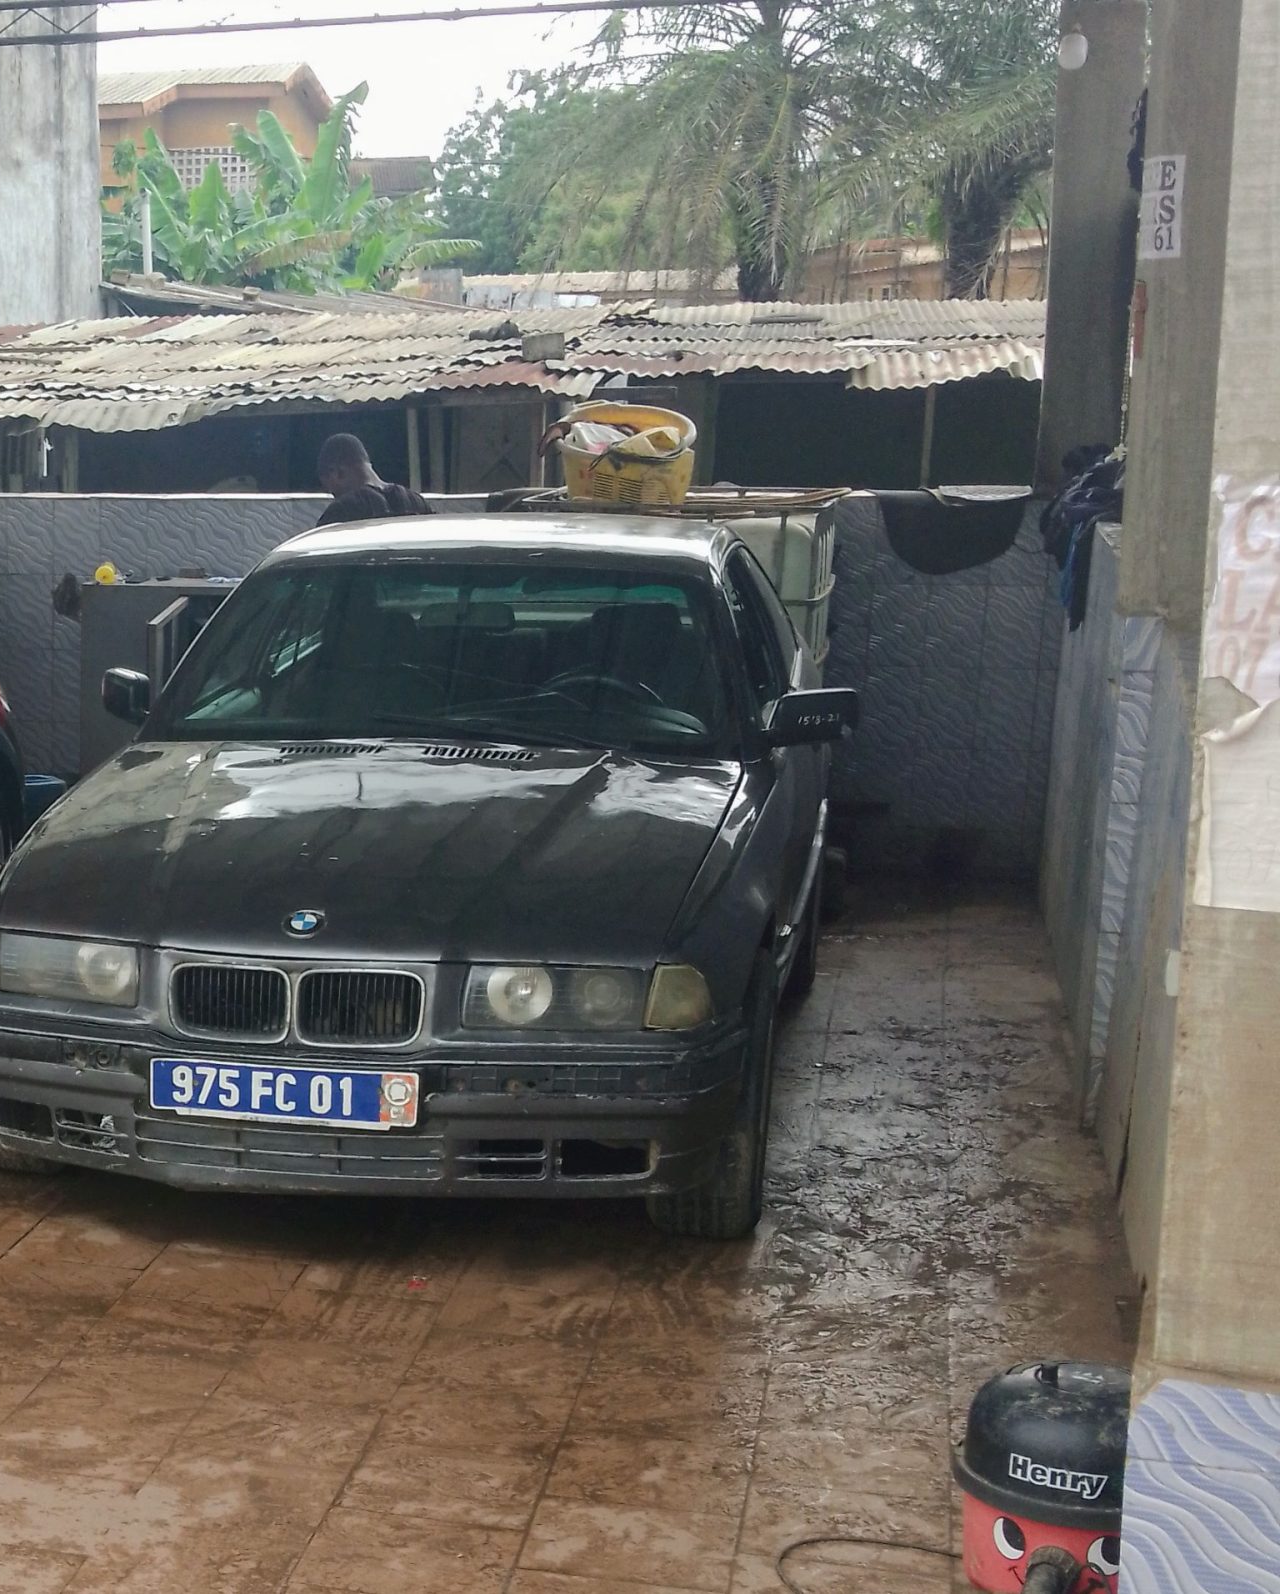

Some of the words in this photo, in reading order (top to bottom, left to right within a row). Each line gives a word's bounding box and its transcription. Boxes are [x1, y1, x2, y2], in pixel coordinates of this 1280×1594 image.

[1153, 226, 1174, 252] 61
[171, 1065, 240, 1108] 975
[251, 1070, 297, 1113] FC
[309, 1076, 353, 1117] 01
[1008, 1452, 1109, 1500] Henry
